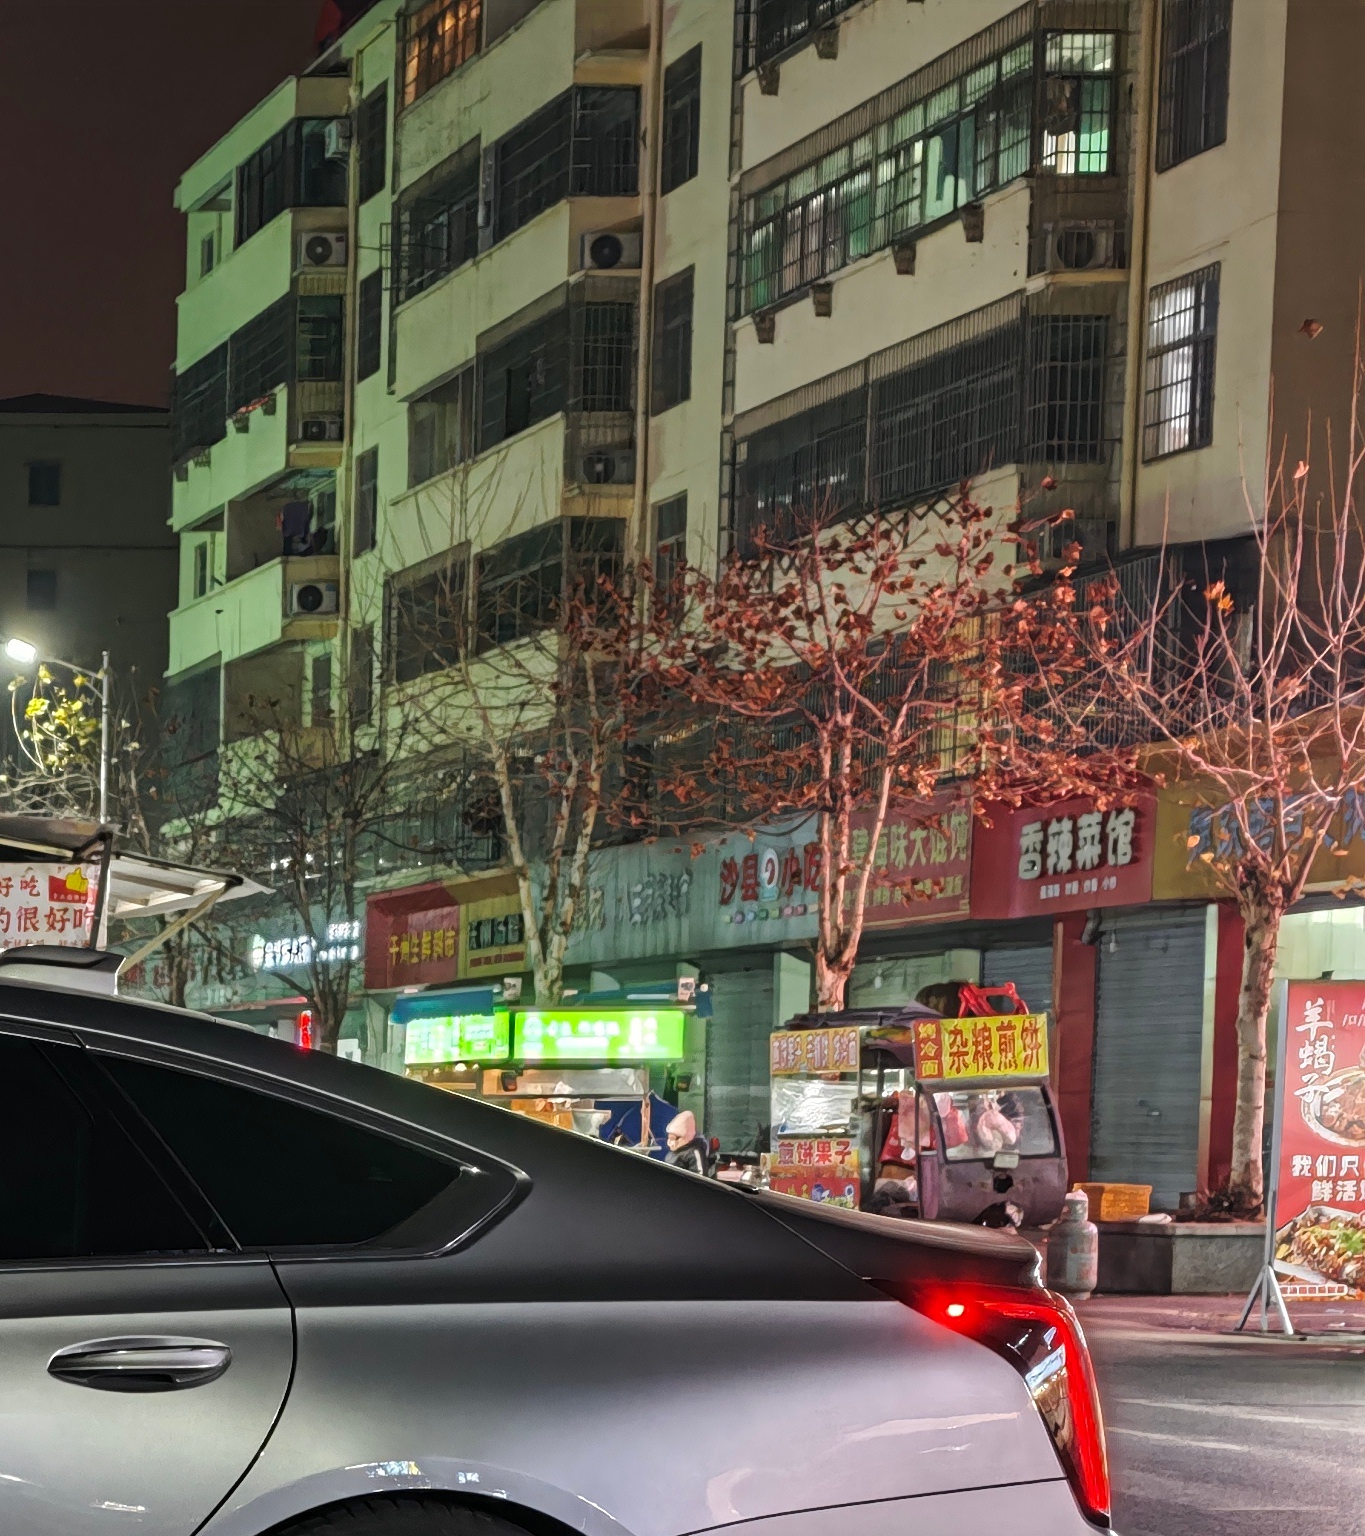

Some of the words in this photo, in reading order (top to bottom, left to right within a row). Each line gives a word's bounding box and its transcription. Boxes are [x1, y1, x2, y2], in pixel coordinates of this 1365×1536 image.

[1018, 806, 1137, 880] 香辣菜馆
[948, 1018, 1043, 1075] 杂粮煎饼
[1292, 1154, 1365, 1177] 我们只
[1311, 1180, 1365, 1202] 鲜活
